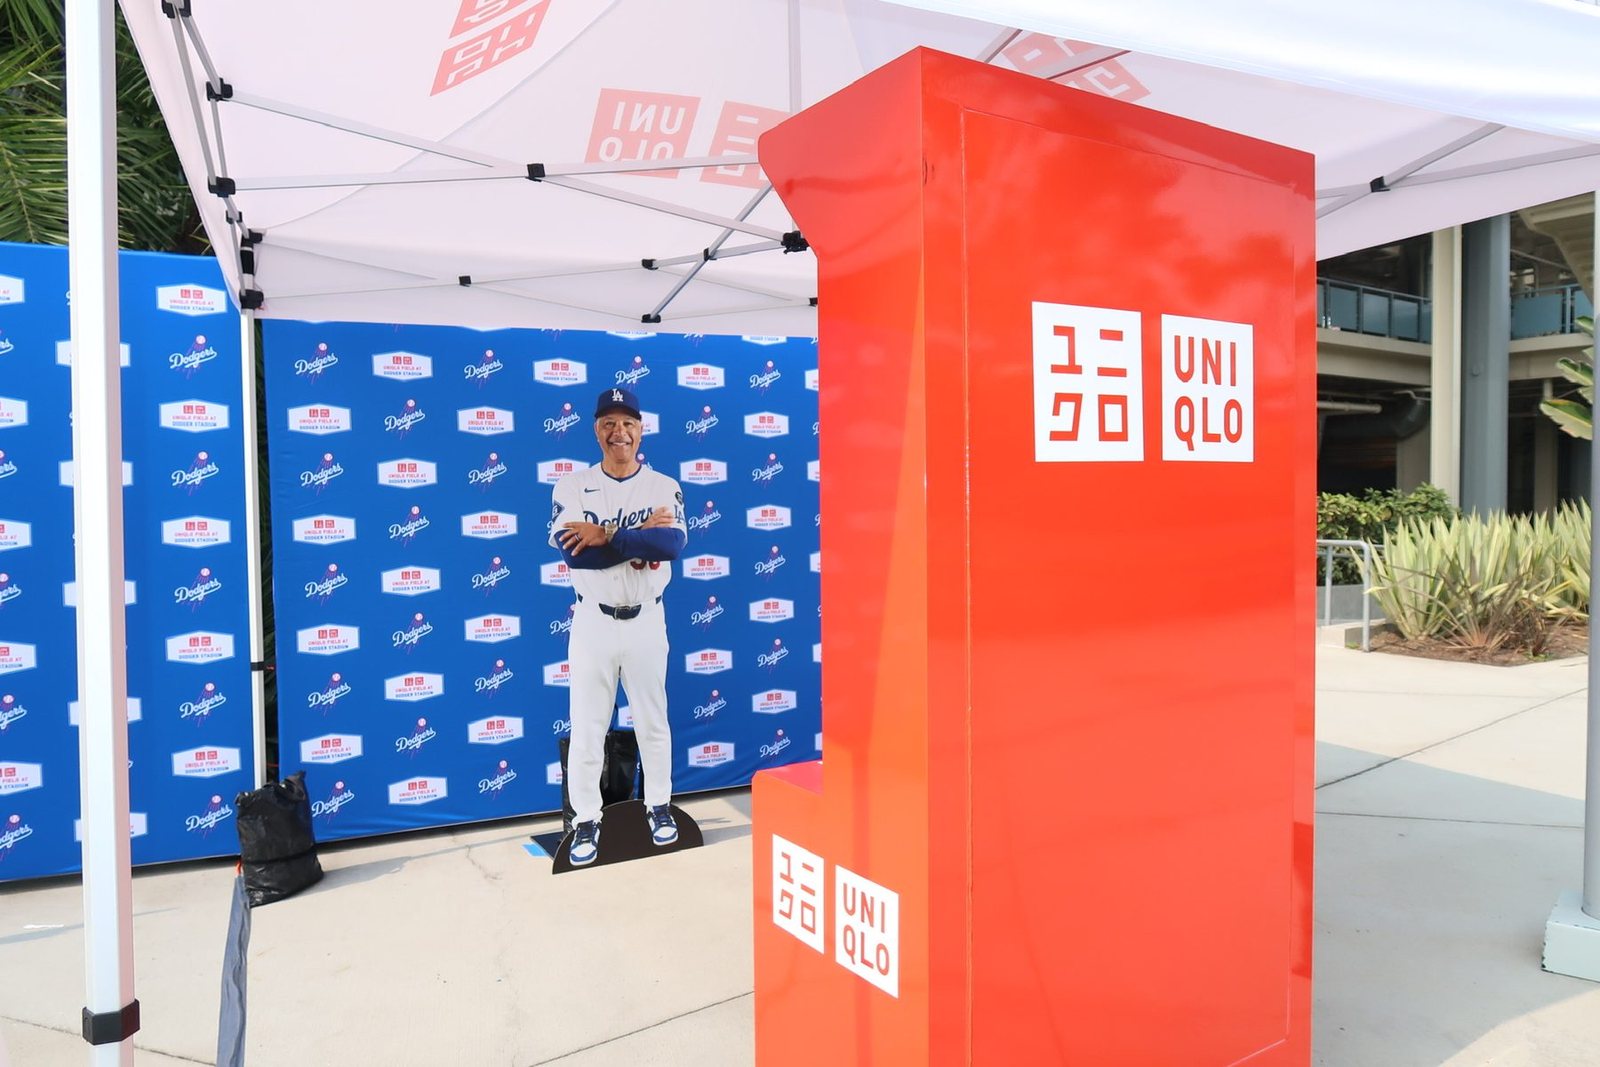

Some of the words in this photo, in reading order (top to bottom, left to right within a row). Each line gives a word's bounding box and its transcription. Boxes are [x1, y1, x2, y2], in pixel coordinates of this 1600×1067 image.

[169, 346, 217, 369] Dodgers
[295, 353, 338, 374] Dodgers
[1174, 335, 1236, 387] UNI
[464, 360, 503, 378] Dodgers
[615, 365, 650, 384] Dodgers
[750, 370, 781, 388] Dodgers
[612, 388, 624, 402] LA
[384, 409, 425, 431] Dodgers
[544, 412, 580, 432] Dodgers
[686, 415, 718, 434] Dodgers
[1174, 396, 1242, 451] QLO
[172, 462, 219, 486] Dodgers
[300, 463, 343, 486] Dodgers
[469, 462, 507, 484] Dodgers
[752, 462, 783, 481] Dodgers
[389, 516, 429, 538] Dodgers
[689, 510, 721, 529] Dodgers
[755, 555, 785, 574] Dodgers
[305, 573, 348, 597] Dodgers
[472, 566, 510, 588] Dodgers
[174, 578, 221, 603] Dodgers
[691, 605, 723, 624] Dodgers
[392, 622, 433, 646] Dodgers
[758, 647, 788, 666] Dodgers
[475, 668, 513, 692] Dodgers
[180, 692, 226, 718] Dodgers
[308, 683, 351, 707] Dodgers
[694, 698, 726, 718] Dodgers
[396, 728, 436, 752] Dodgers
[760, 737, 790, 757] Dodgers
[478, 770, 516, 793] Dodgers
[312, 790, 354, 816] Dodgers
[186, 805, 232, 831] Dodgers
[843, 883, 885, 933] UNI
[843, 924, 890, 976] QLO
